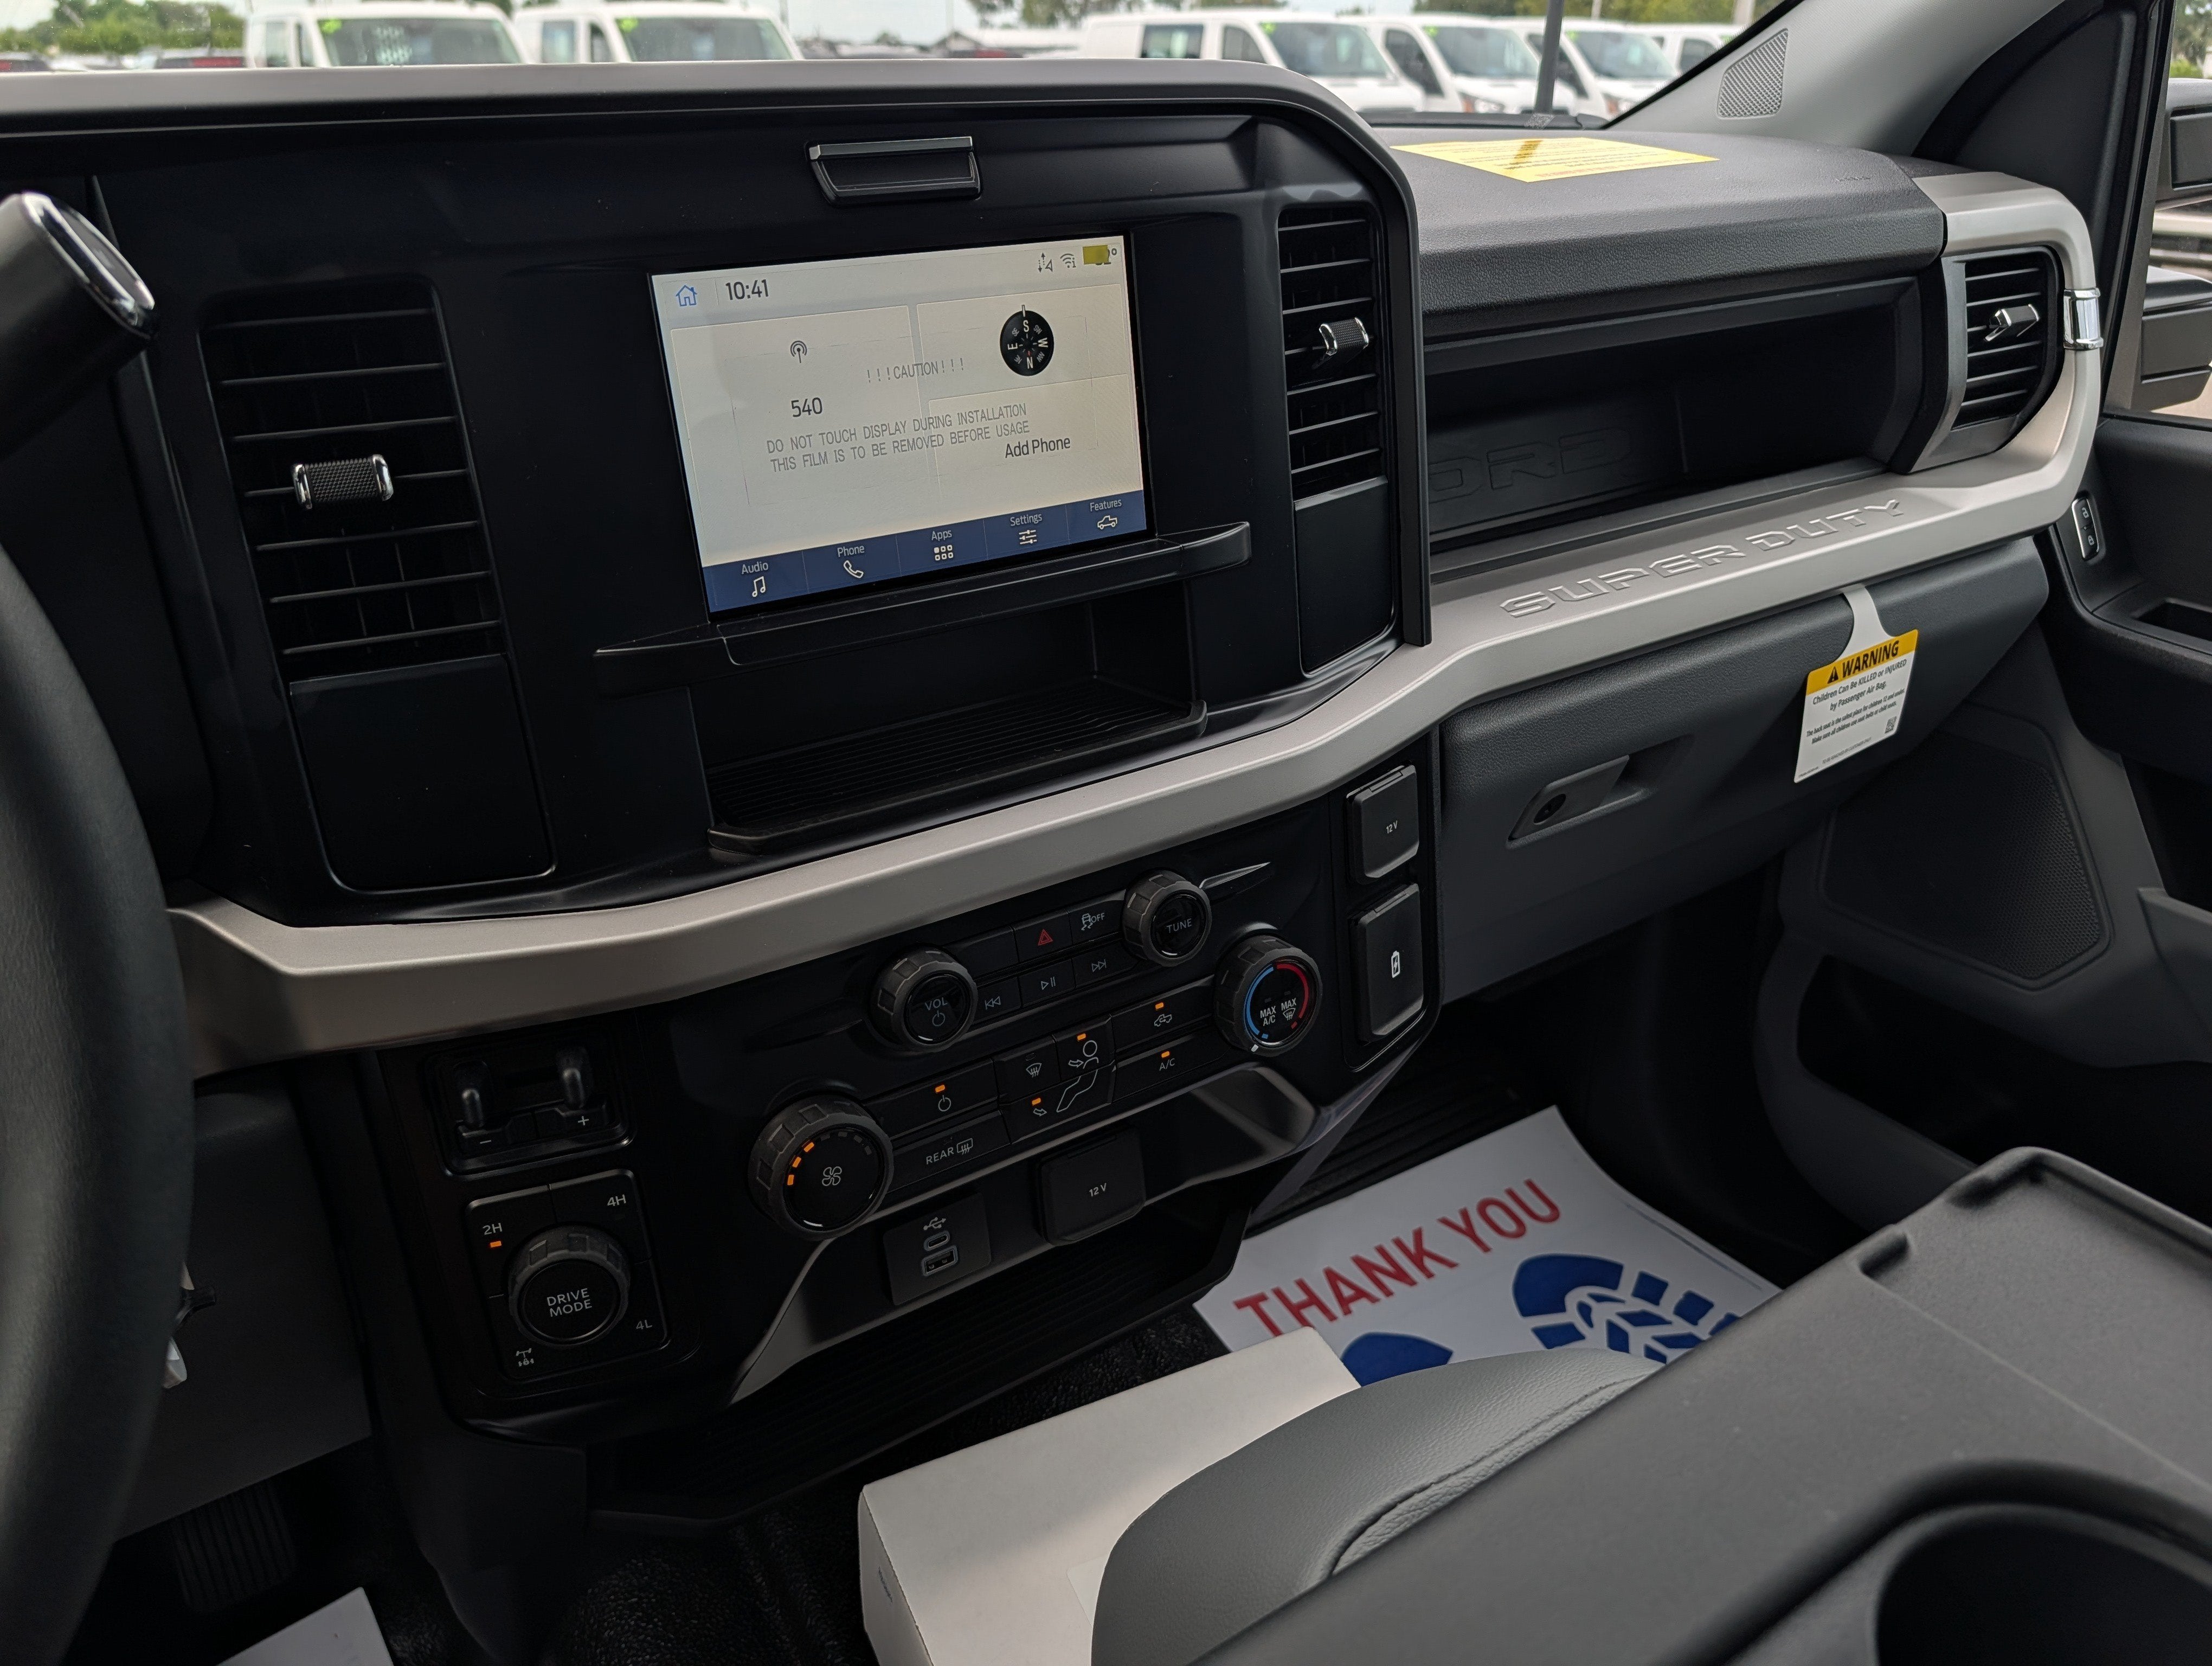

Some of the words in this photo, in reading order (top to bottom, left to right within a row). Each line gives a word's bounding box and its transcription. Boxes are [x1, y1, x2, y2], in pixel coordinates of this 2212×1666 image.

[725, 279, 769, 300] 10:41
[1023, 319, 1030, 332] S
[1007, 342, 1018, 350] E
[1038, 337, 1049, 348] W
[1026, 356, 1033, 369] N
[791, 397, 822, 417] 540
[767, 439, 784, 454] DO
[790, 434, 813, 451] NOT
[819, 428, 858, 446] TOUCH
[863, 420, 907, 440] DISPLAY
[912, 413, 953, 432] DURING
[957, 403, 1027, 426] INSTALLATION
[770, 456, 797, 472] THIS
[802, 451, 828, 468] FILM
[834, 448, 845, 463] IS
[850, 446, 866, 460] TO
[871, 442, 888, 457] BE
[892, 434, 944, 454] REMOVED
[950, 426, 991, 445] BEFORE
[995, 420, 1030, 438] USAGE
[1005, 440, 1030, 459] Add
[1032, 437, 1071, 453] Phone
[1427, 426, 1631, 504] ORD
[1090, 499, 1122, 512] Features
[1009, 514, 1043, 527] Settings
[931, 528, 953, 542] Apps
[837, 544, 865, 558] Phone
[1500, 544, 1747, 618] SUPER
[1745, 499, 1904, 552] DUTY
[741, 561, 769, 575] Audio
[1842, 640, 1900, 678] WARNING
[1813, 690, 1837, 704] Children
[1838, 684, 1849, 694] Can
[1850, 681, 1857, 689] Be
[1858, 672, 1876, 686] KILLED
[1884, 658, 1907, 674] INJURED
[1830, 703, 1837, 712] by
[1838, 689, 1866, 707] Passenger
[1866, 683, 1874, 694] Air
[1090, 912, 1105, 923] OFF
[1166, 918, 1192, 933] TUNE
[924, 997, 948, 1011] VOL
[1281, 998, 1297, 1011] MAX
[1260, 1005, 1276, 1018] MAX
[1263, 1015, 1276, 1027] A/C
[1159, 1058, 1175, 1071] A/C
[925, 1146, 954, 1165] REAR
[607, 1194, 627, 1207] 4H
[482, 1222, 503, 1235] 2H
[1234, 1226, 1459, 1337] THANK
[1437, 1178, 1561, 1253] YOU
[546, 1287, 590, 1306] DRIVE
[549, 1299, 593, 1317] MODE
[635, 1319, 653, 1330] 4L
